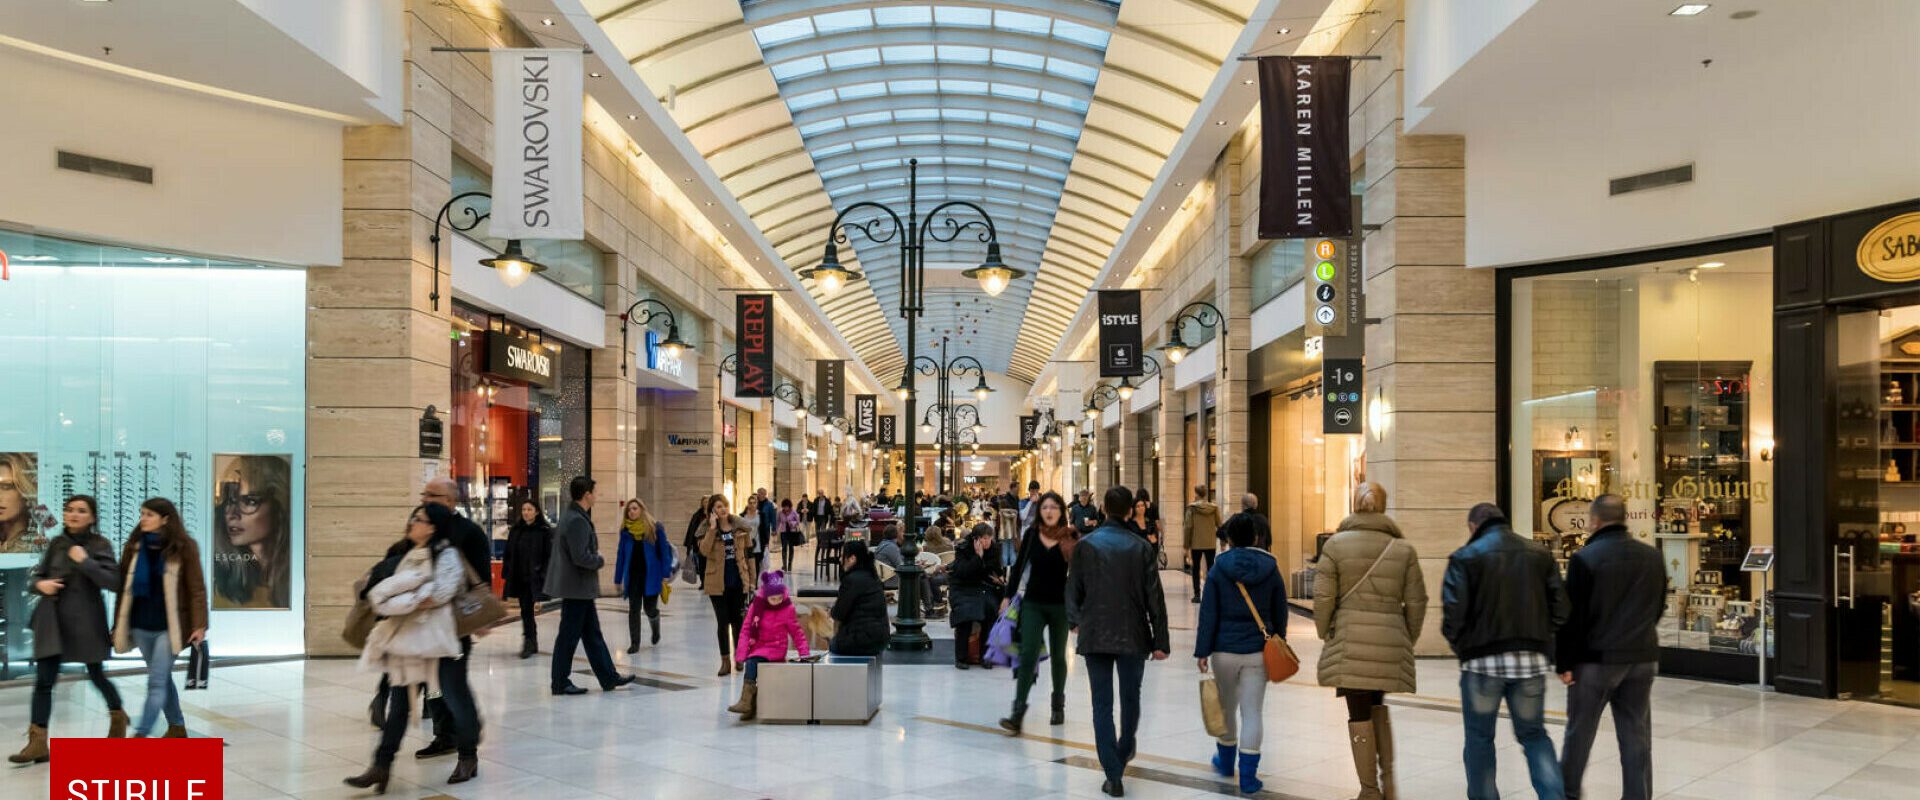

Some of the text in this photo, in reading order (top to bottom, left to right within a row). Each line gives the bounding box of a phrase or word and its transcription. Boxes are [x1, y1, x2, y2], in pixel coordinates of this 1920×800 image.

[523, 56, 549, 228] SWAROVSKI
[1297, 64, 1312, 225] KAREN MILLEN
[1882, 234, 1920, 261] SAB
[1102, 314, 1138, 326] iSTYLE
[1350, 287, 1358, 324] CHAMPS
[507, 345, 550, 378] SWAROVSKI
[743, 298, 765, 395] REPLAY
[859, 399, 873, 436] VANS
[883, 417, 892, 442] ecco
[1672, 471, 1769, 504] Giving
[1570, 518, 1585, 530] 50
[215, 553, 257, 561] ESCADA
